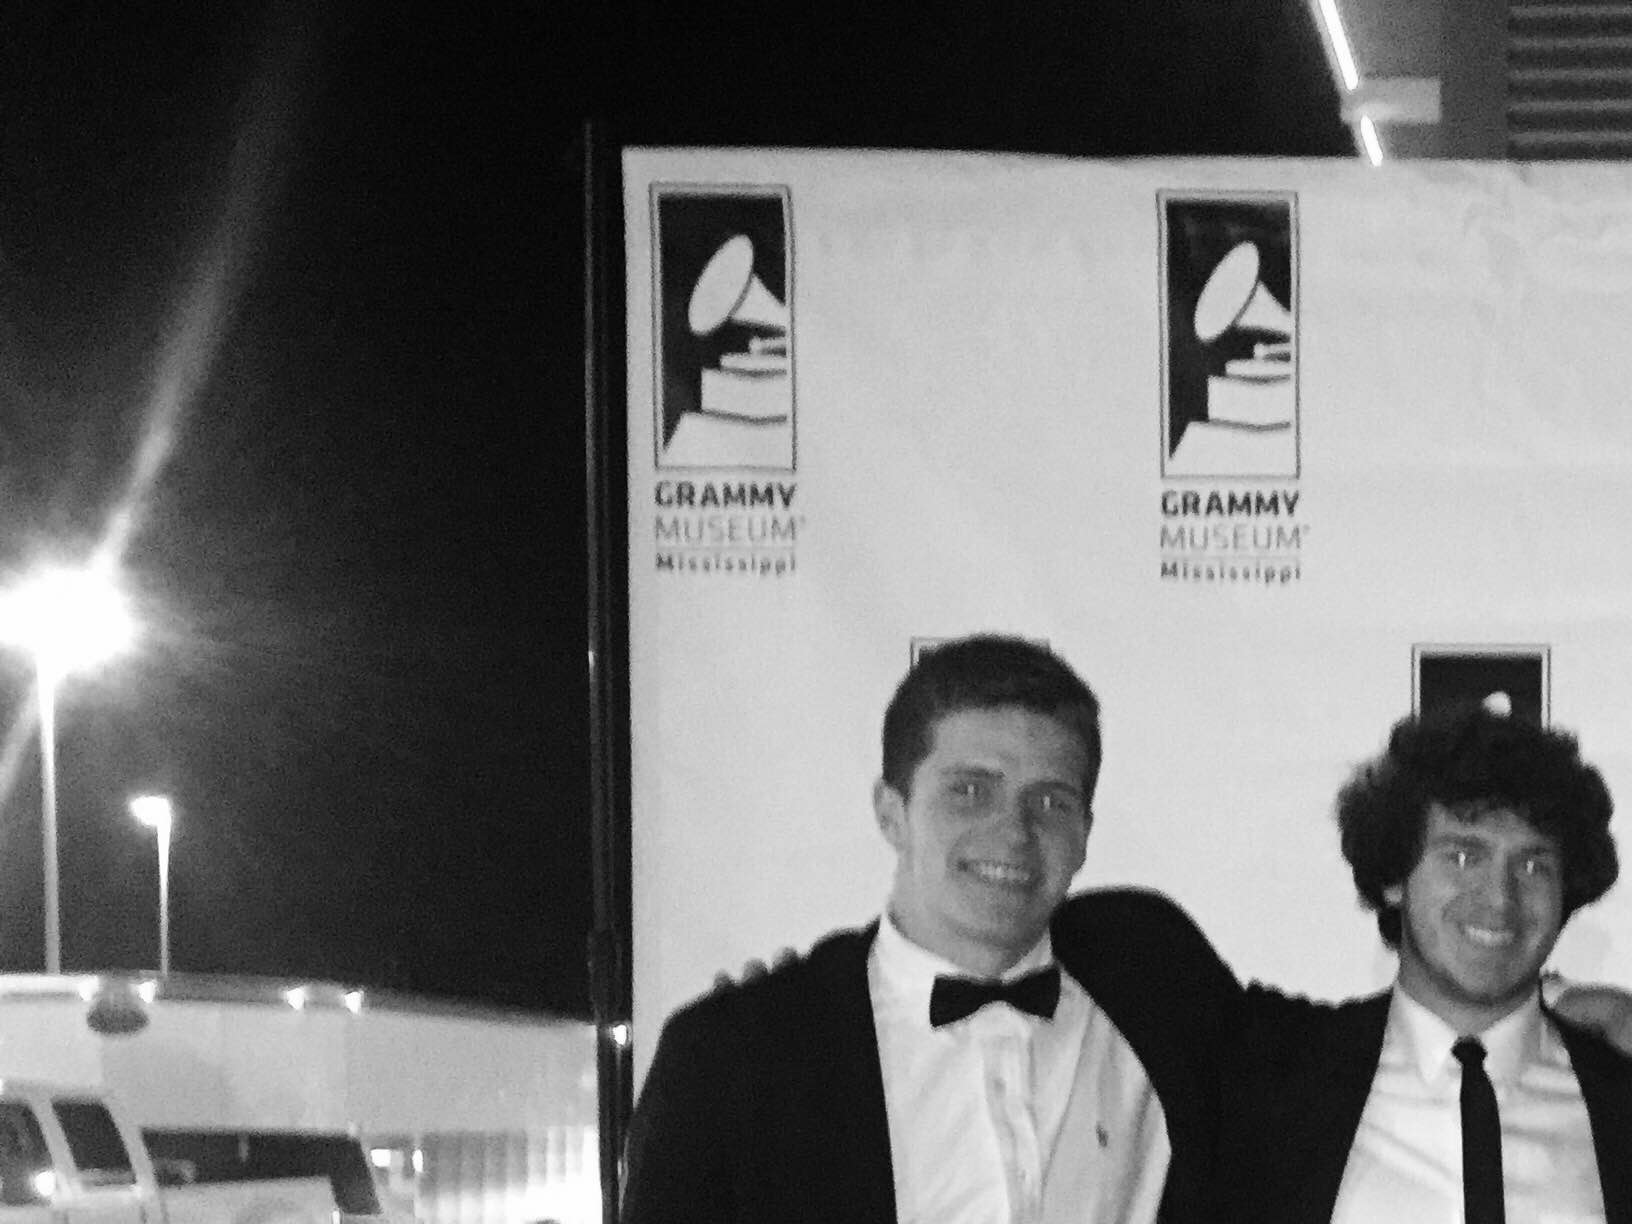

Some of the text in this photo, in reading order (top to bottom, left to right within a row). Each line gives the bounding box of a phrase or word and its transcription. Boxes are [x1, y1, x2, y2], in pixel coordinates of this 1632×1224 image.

[655, 481, 796, 509] GRAMMY
[1161, 490, 1300, 517] GRAMMY
[655, 553, 797, 576] Mississippi
[1160, 562, 1301, 584] Mississippi
